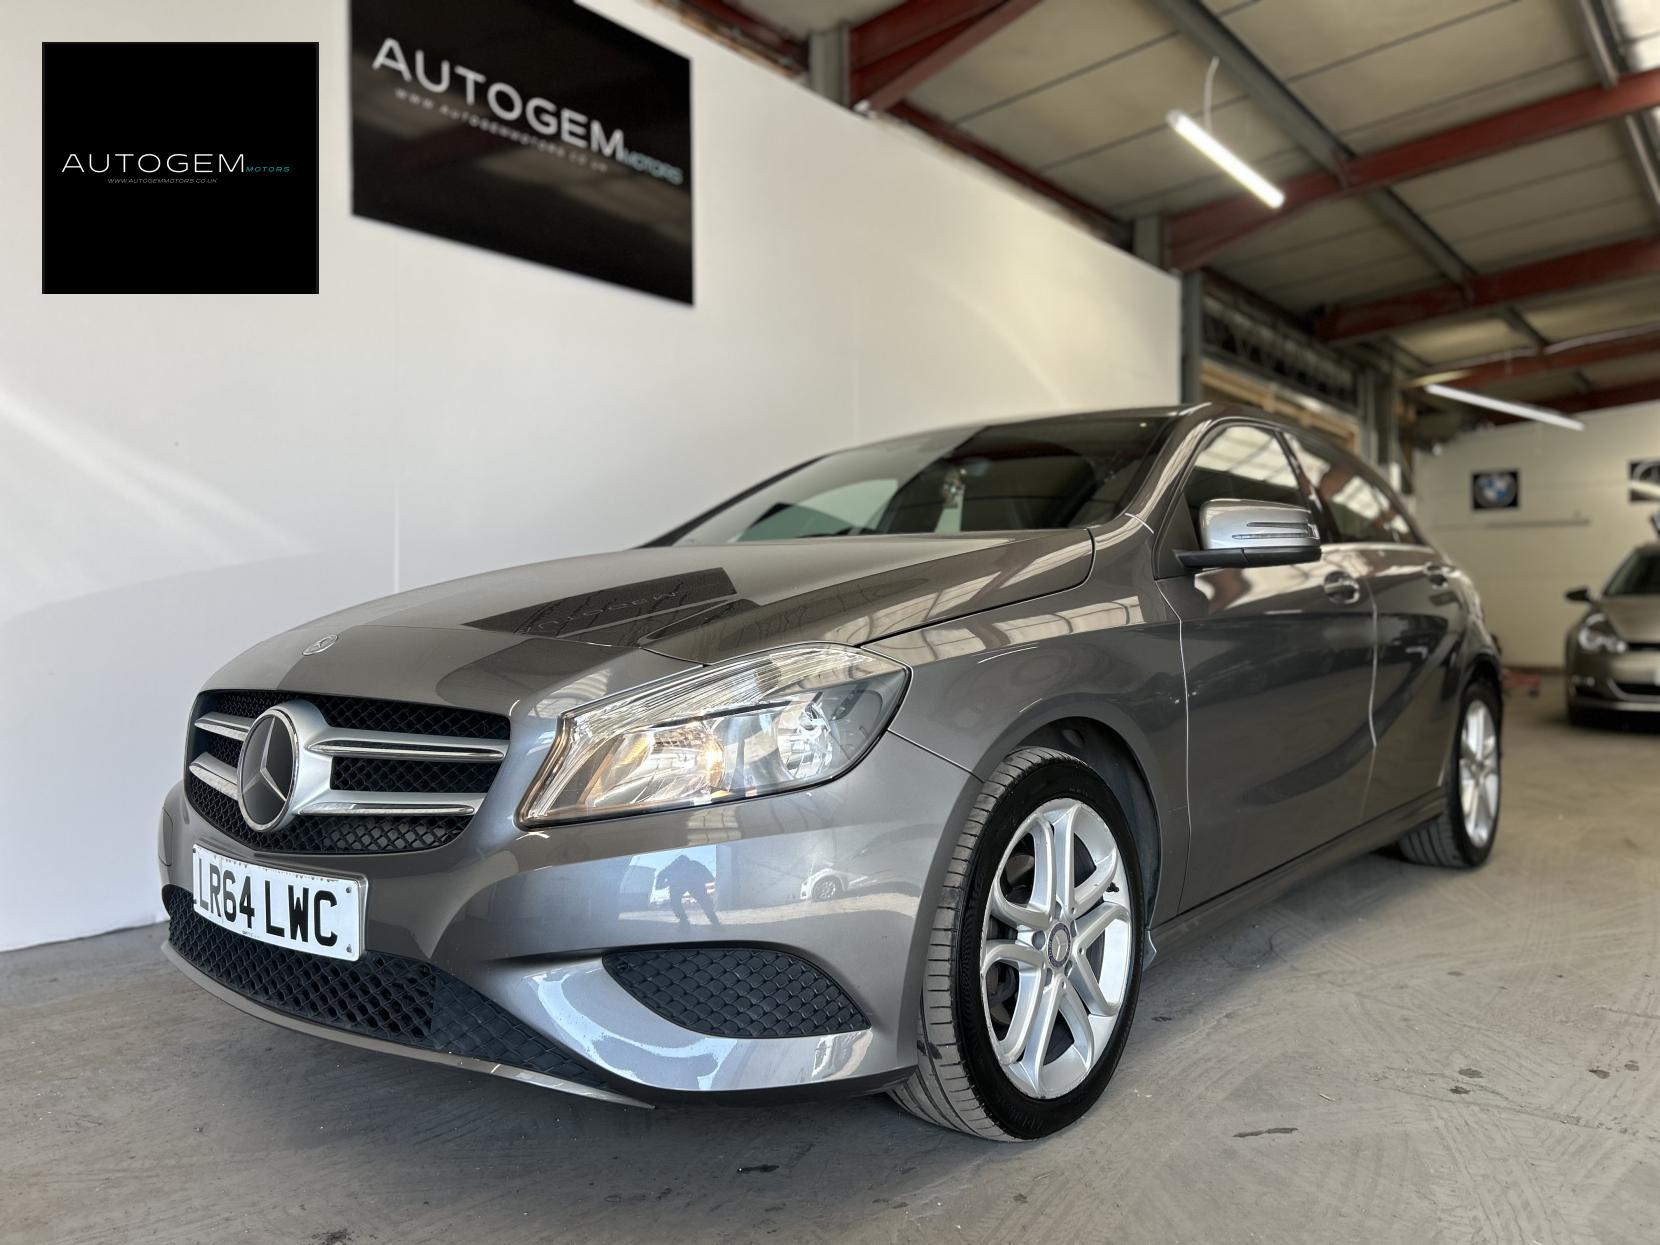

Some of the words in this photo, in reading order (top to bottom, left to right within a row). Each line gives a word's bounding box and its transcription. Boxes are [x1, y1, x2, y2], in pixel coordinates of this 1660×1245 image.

[372, 37, 624, 161] AUTOGEM
[622, 148, 683, 185] MOTORS
[199, 858, 255, 929] LR64
[264, 880, 338, 947] LWC
